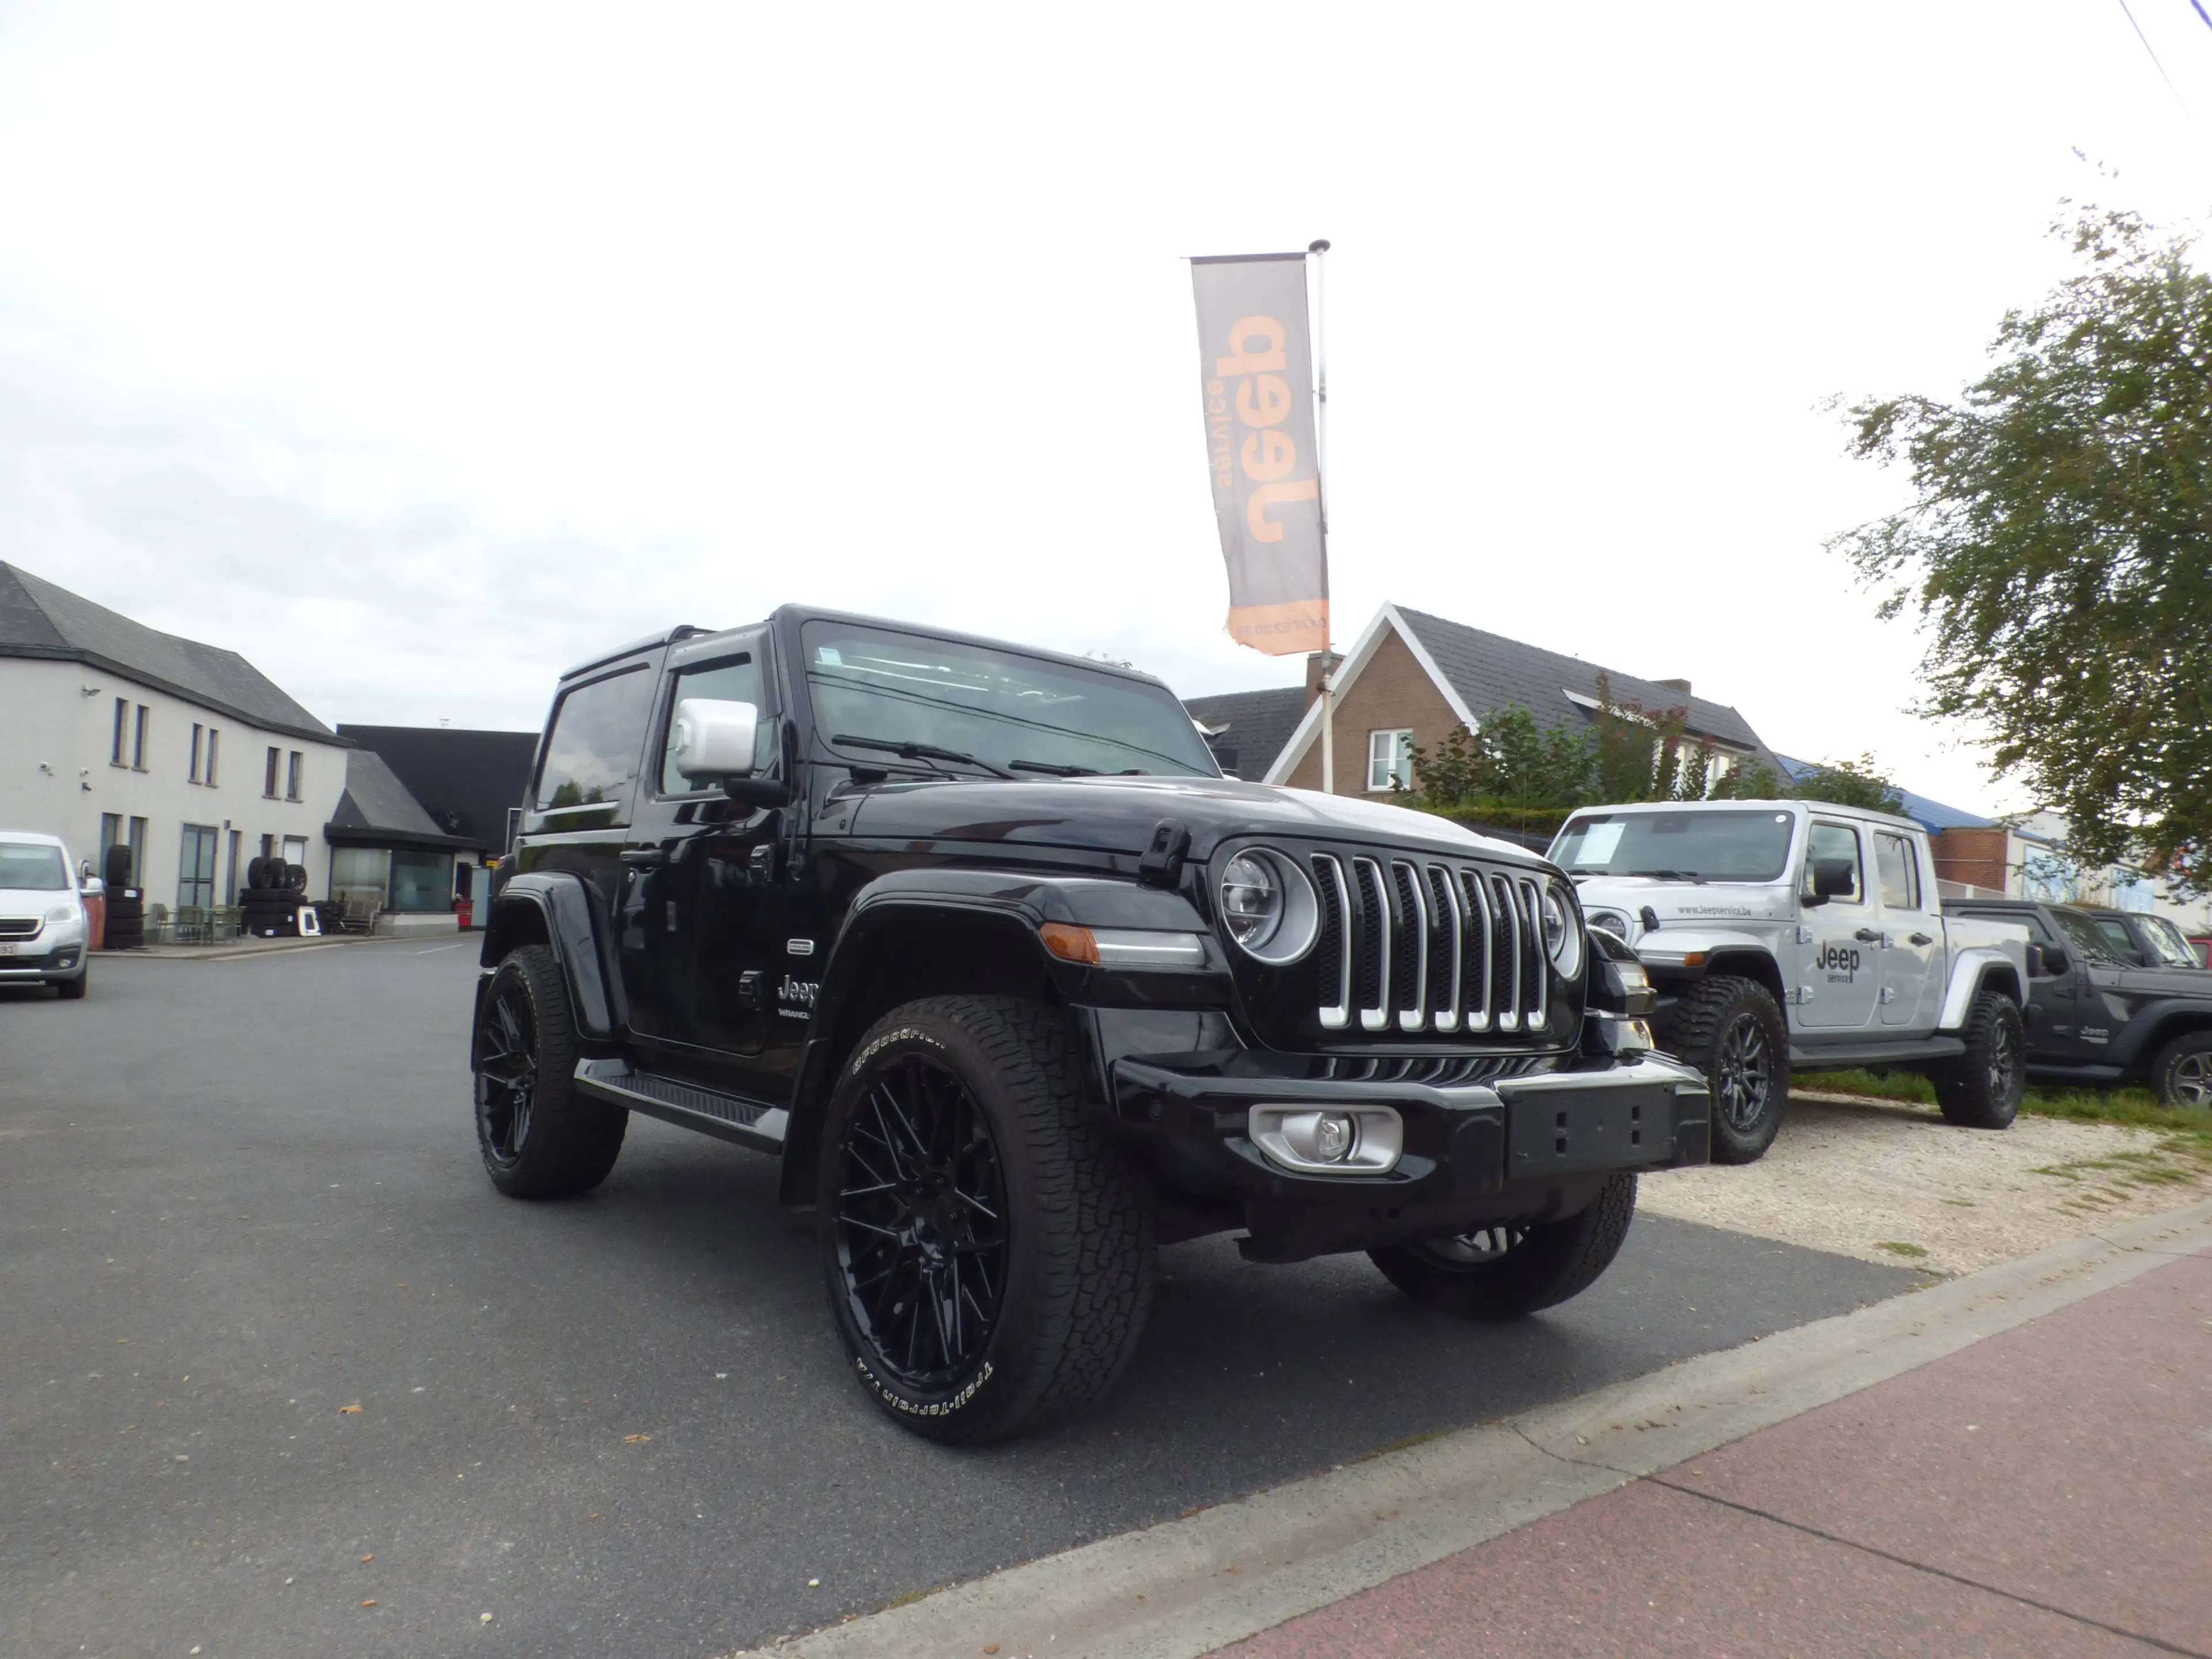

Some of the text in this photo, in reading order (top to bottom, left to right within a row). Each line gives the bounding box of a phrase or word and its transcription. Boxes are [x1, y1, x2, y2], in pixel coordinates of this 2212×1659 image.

[1816, 940, 1859, 983] Jeep
[1827, 973, 1849, 983] service
[778, 975, 820, 1007] Jeep
[779, 1007, 810, 1020] WRANGL
[2080, 1025, 2109, 1037] Jeep
